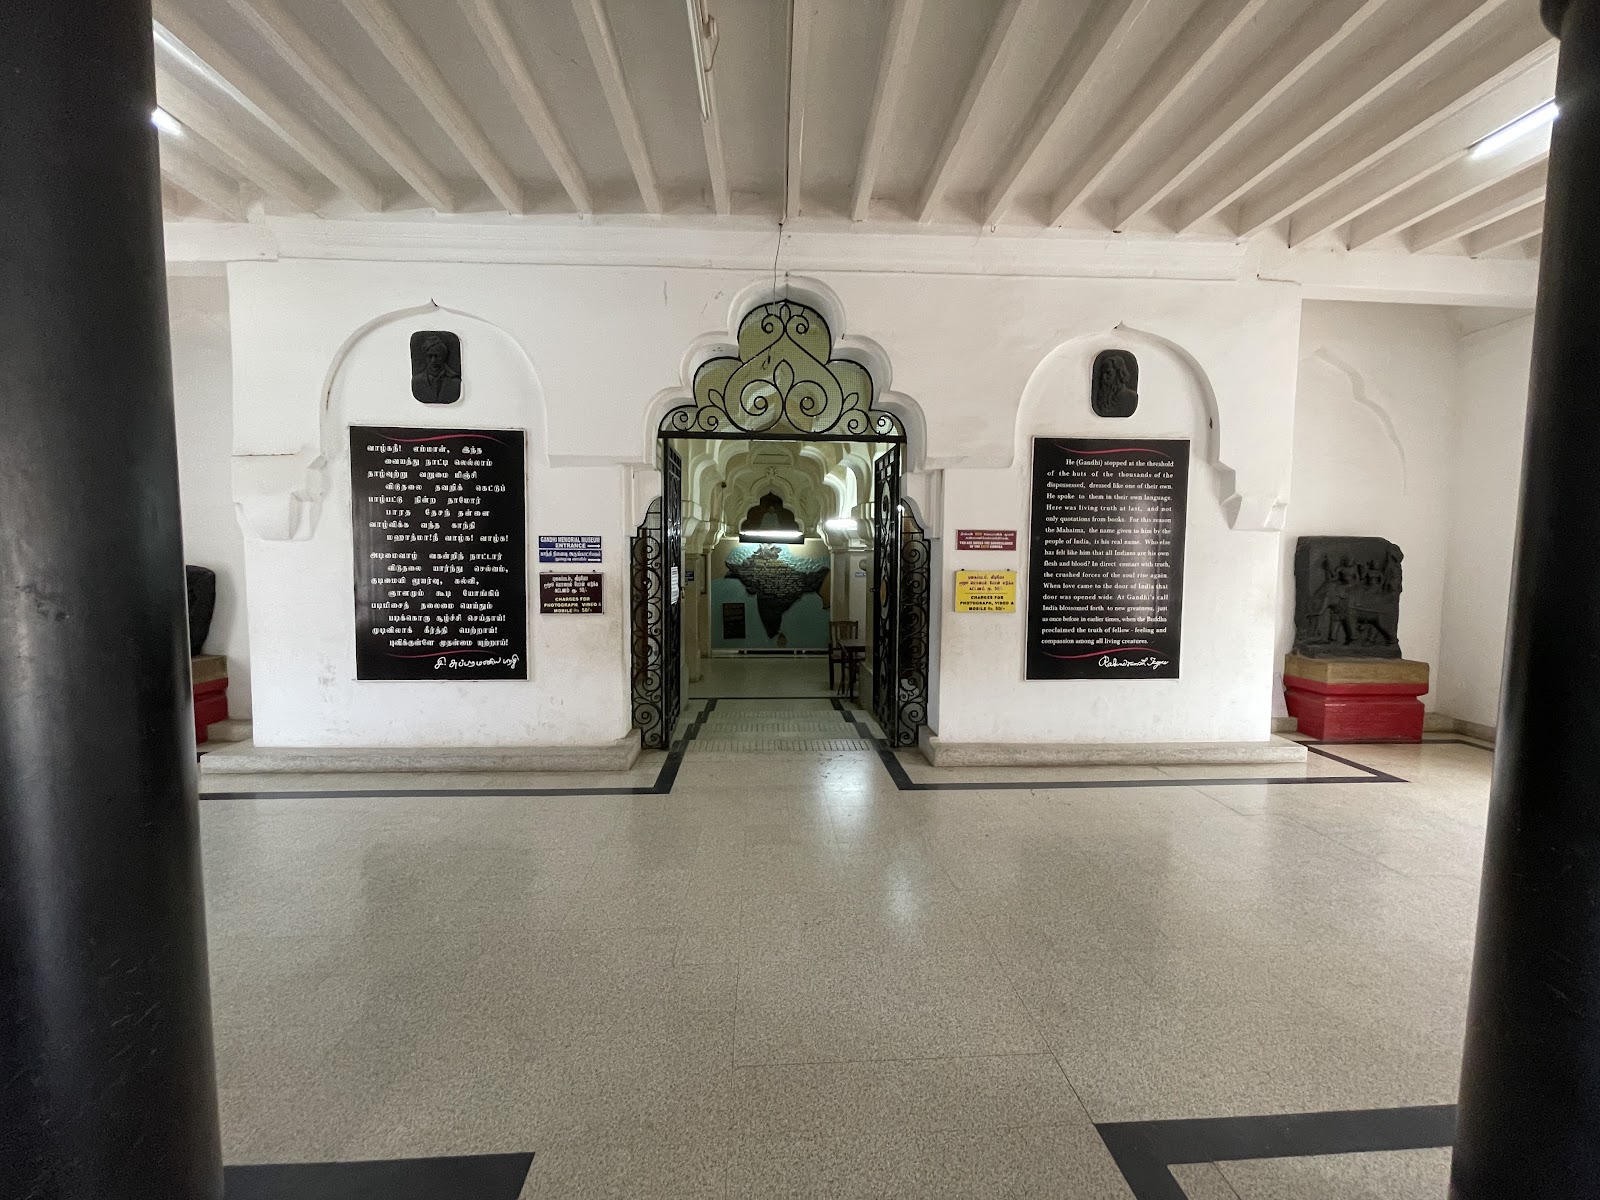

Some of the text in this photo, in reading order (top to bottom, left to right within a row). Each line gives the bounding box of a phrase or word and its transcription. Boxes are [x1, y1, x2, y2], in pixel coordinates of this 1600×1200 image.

[1076, 458, 1103, 466] (Gandhi)
[1104, 459, 1127, 467] stopped
[1046, 481, 1086, 489] dispossessed,
[1057, 492, 1075, 500] spoke
[1144, 494, 1172, 502] language.
[1078, 504, 1098, 512] living
[1042, 626, 1075, 634] proclaimed
[1104, 637, 1120, 645] living
